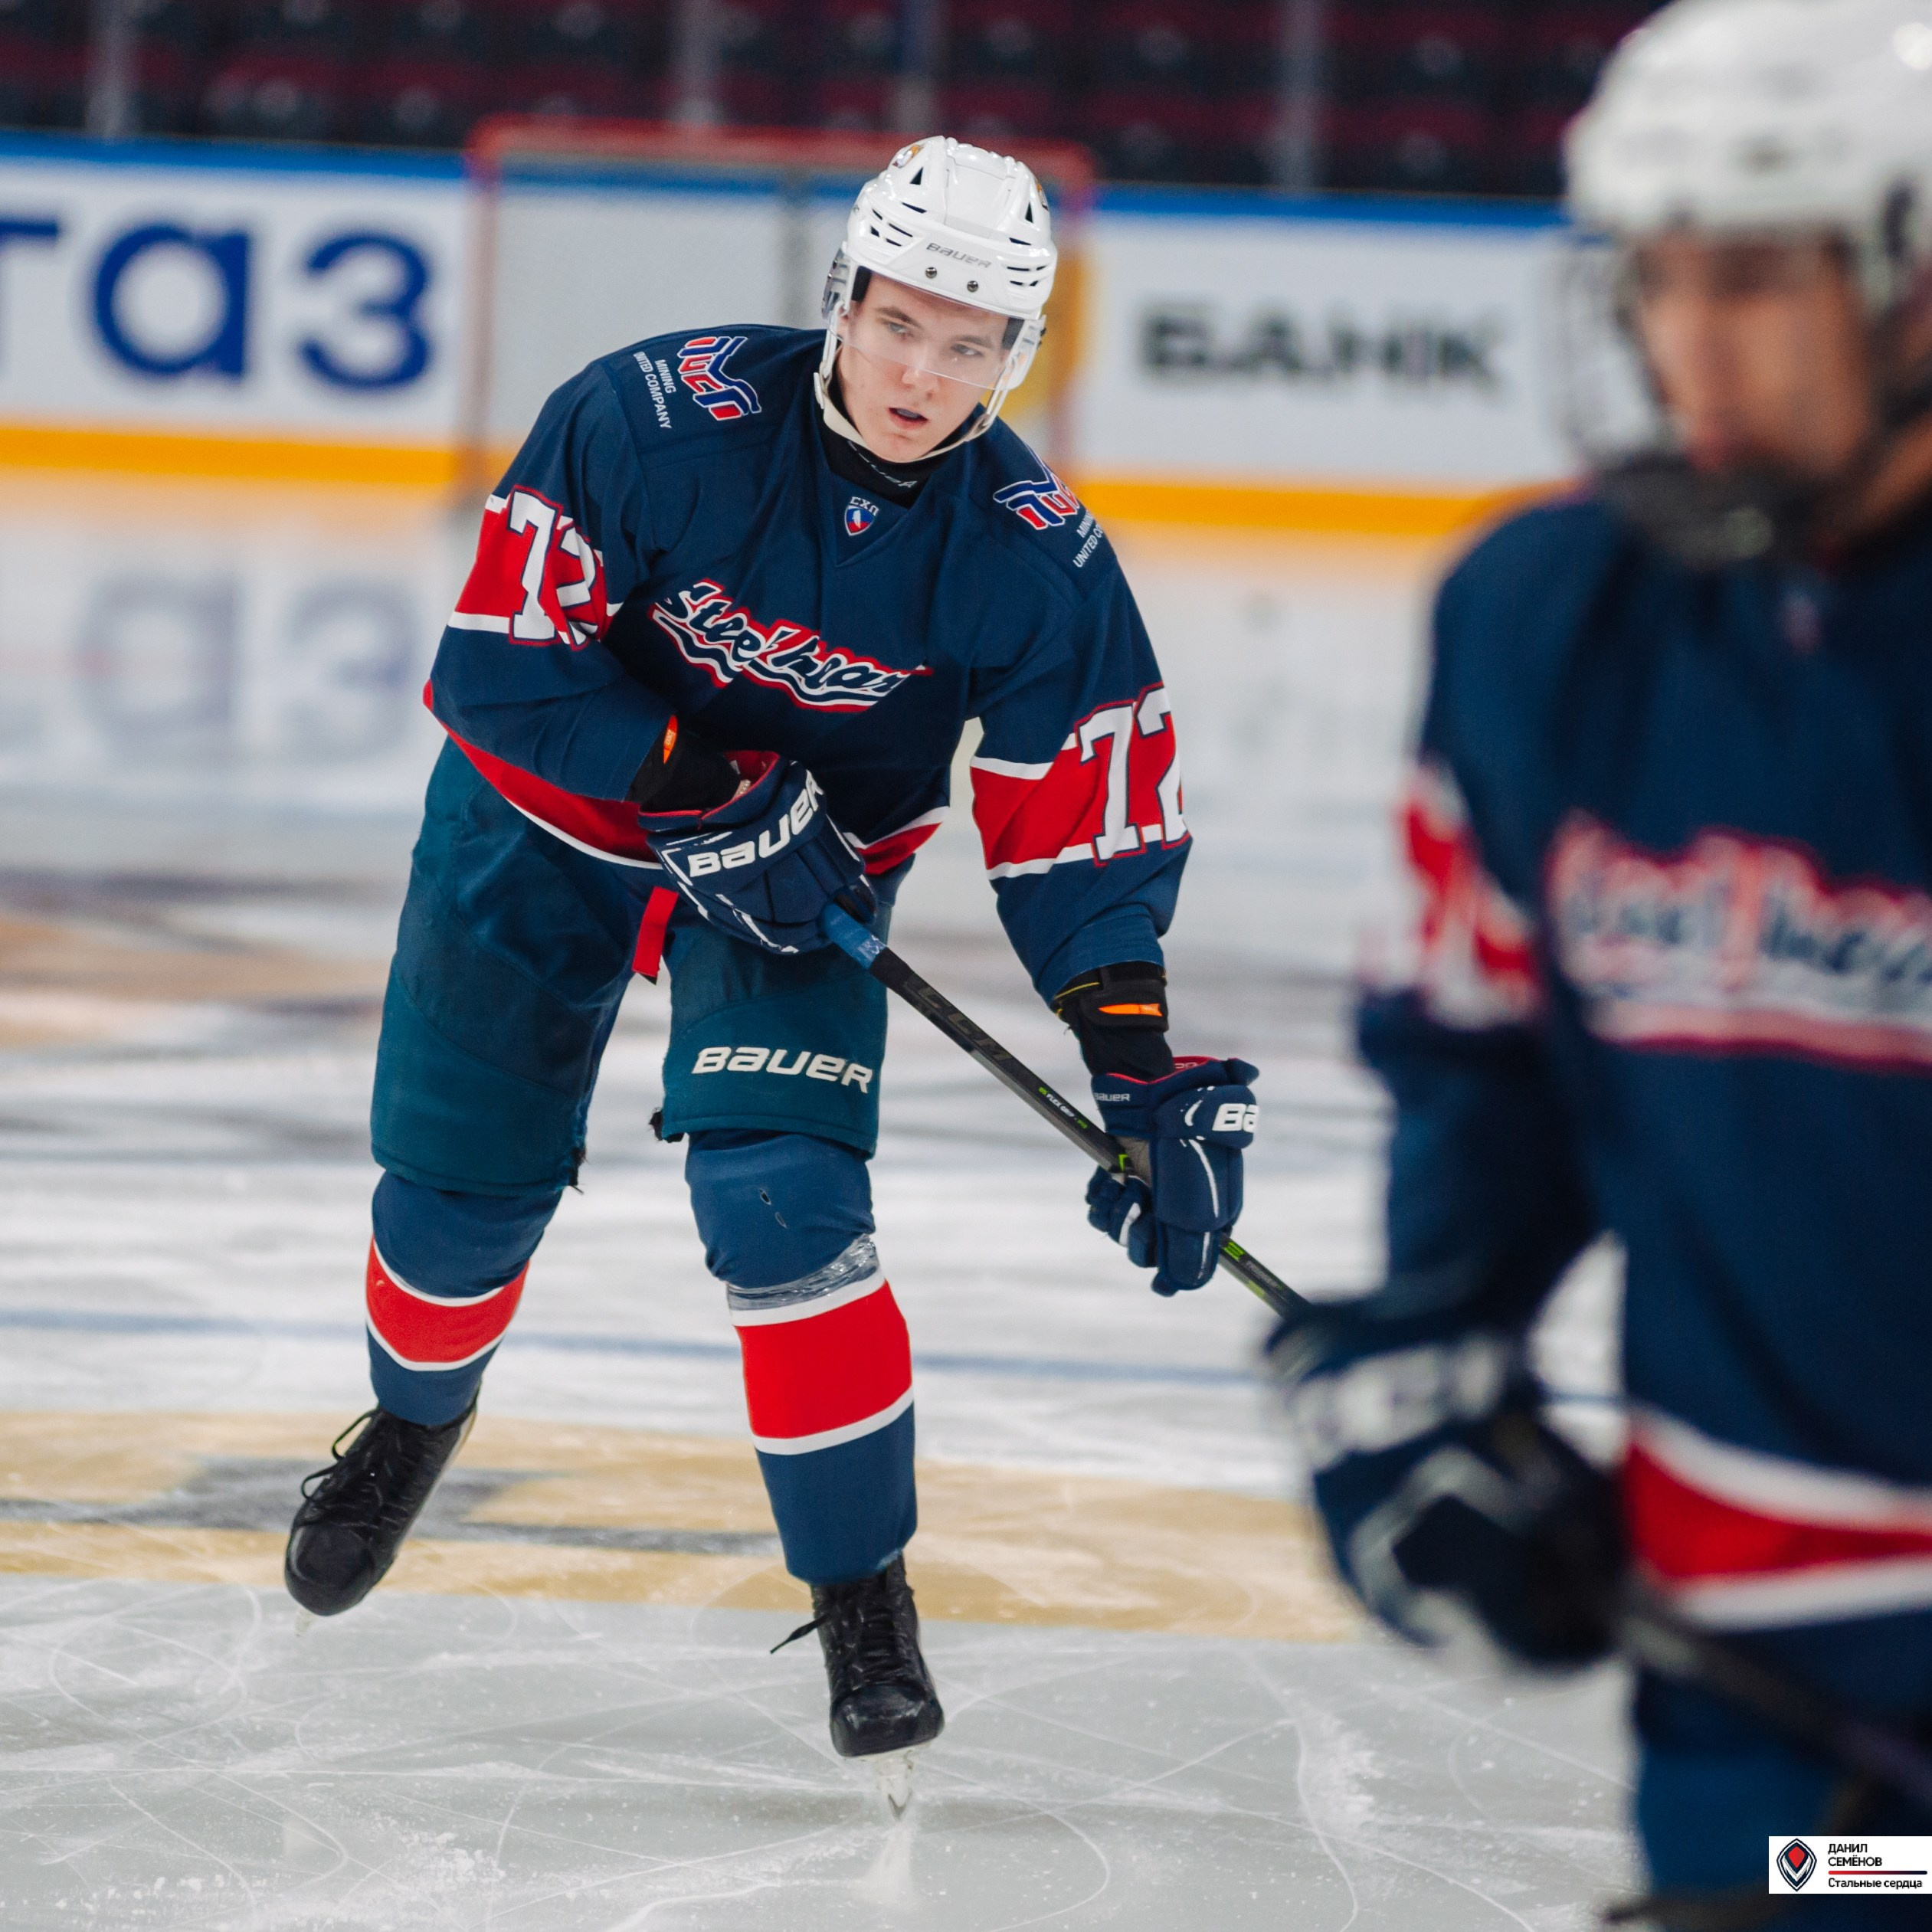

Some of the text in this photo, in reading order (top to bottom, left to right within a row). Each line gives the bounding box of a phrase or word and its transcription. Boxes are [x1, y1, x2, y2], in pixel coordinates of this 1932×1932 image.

[925, 242, 993, 269] BAUER
[654, 359, 676, 394] MINING
[645, 373, 672, 429] COMPANY
[1076, 509, 1095, 539] MININ
[507, 484, 603, 651] 72
[1072, 534, 1098, 568] UNITED
[687, 768, 825, 879] BAUER
[691, 1046, 873, 1094] BAUER
